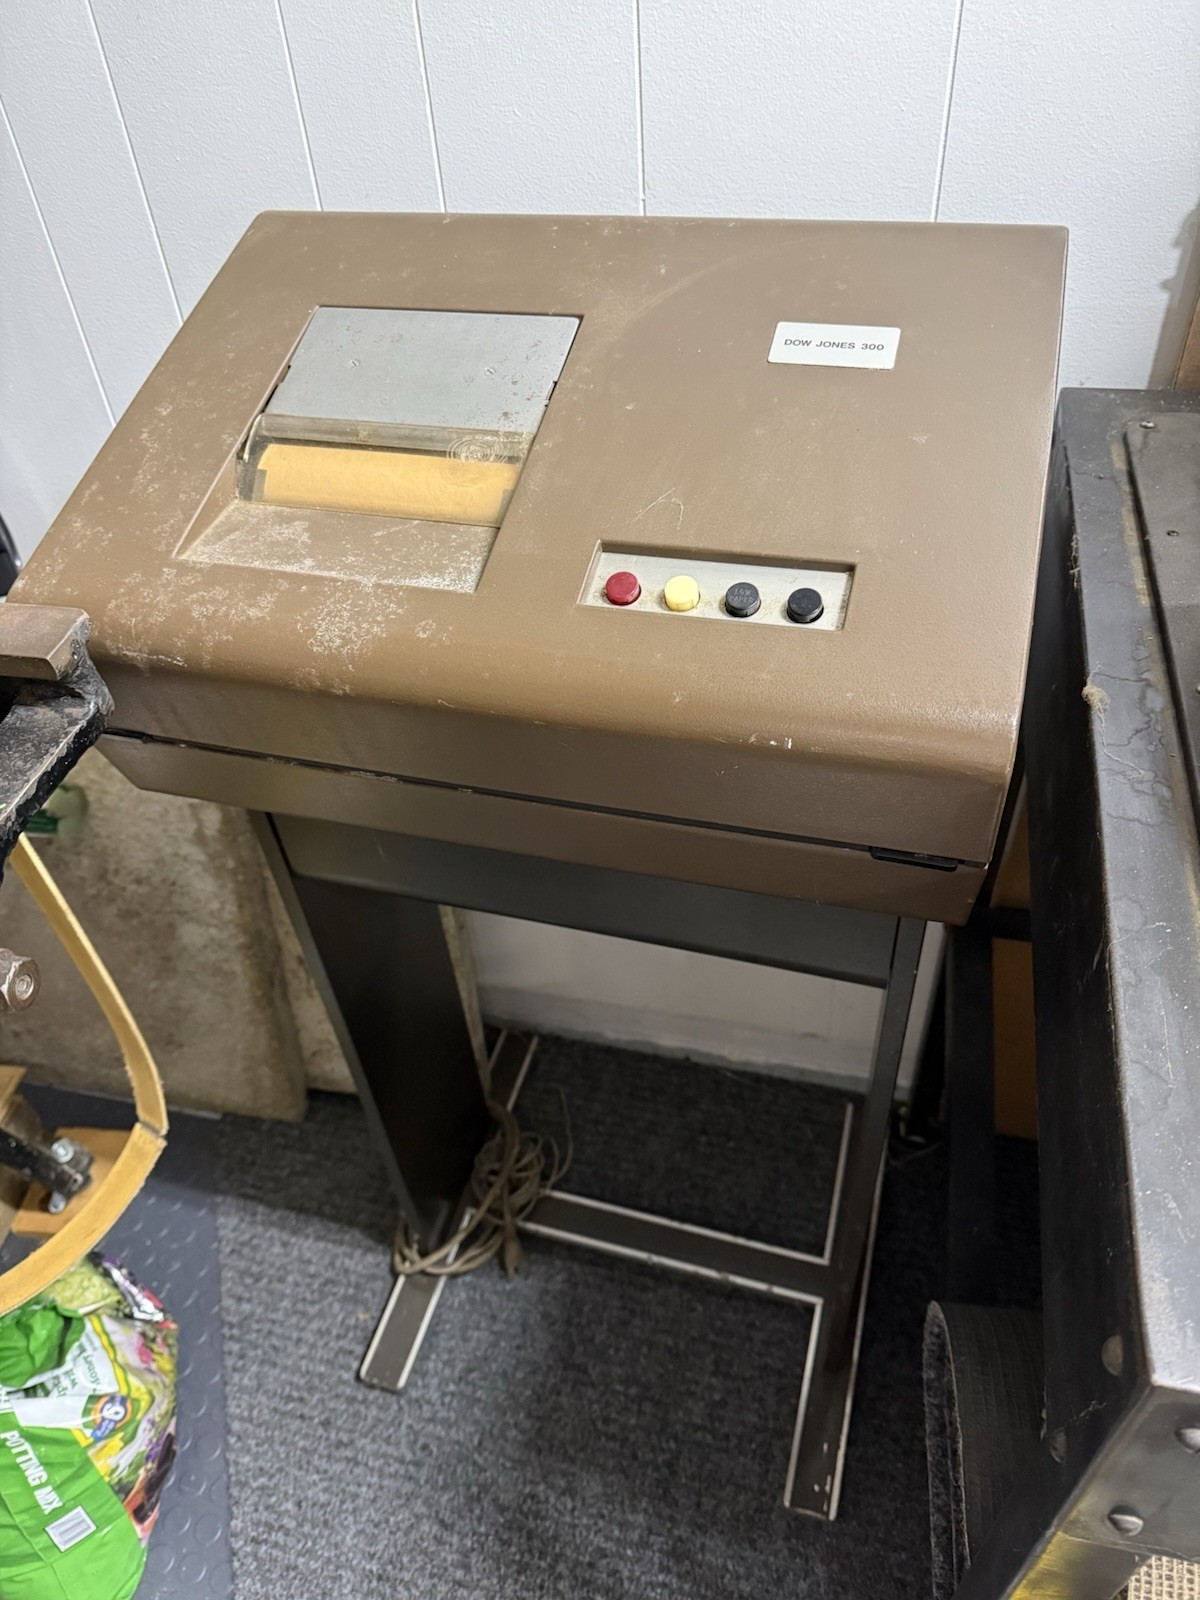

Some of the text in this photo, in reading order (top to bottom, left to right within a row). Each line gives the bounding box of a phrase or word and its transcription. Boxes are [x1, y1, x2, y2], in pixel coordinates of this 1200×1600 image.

[784, 338, 885, 351] DOW JONES 300
[733, 588, 752, 596] LOW
[0, 1430, 64, 1515] POTTING MIX
